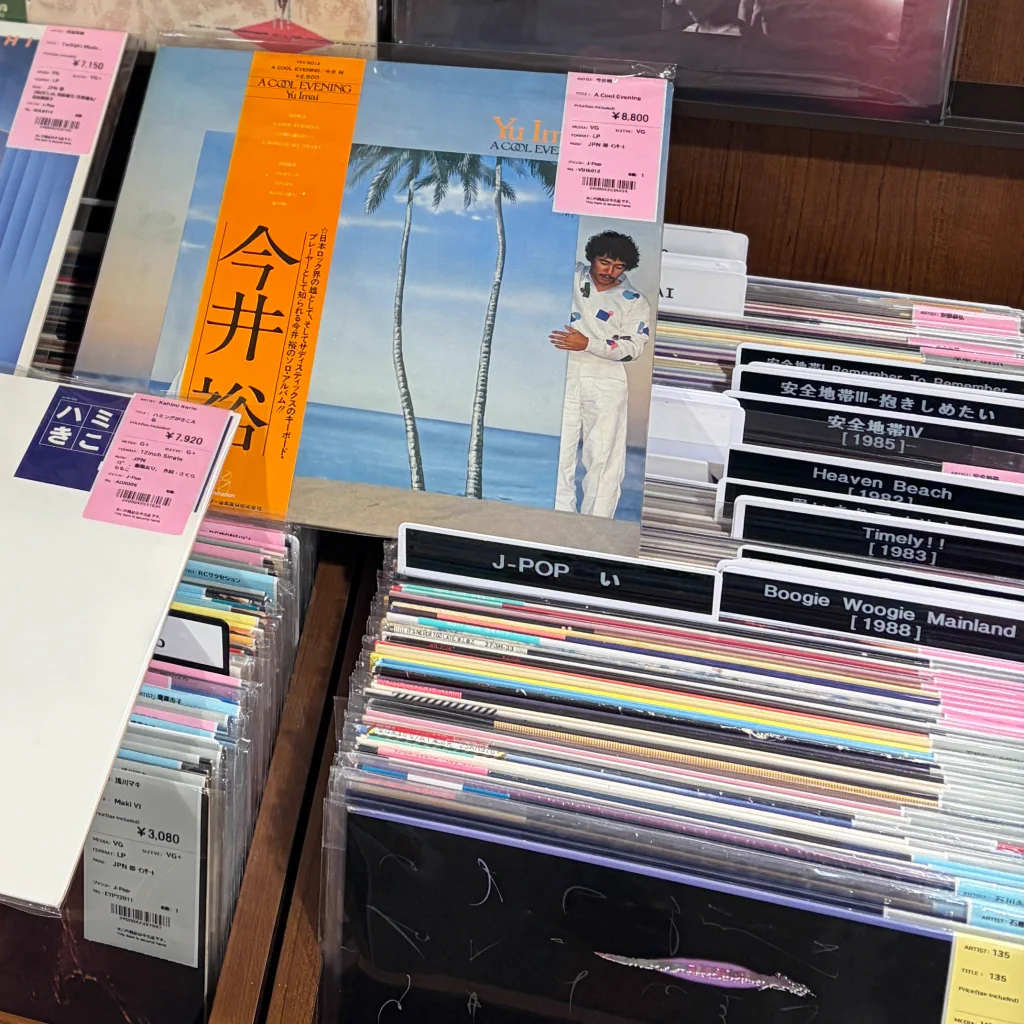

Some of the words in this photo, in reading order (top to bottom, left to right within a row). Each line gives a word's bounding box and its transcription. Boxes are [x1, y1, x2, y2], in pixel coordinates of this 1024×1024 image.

[73, 59, 104, 70] ¥7,150
[258, 78, 266, 88] A
[268, 79, 296, 90] COOL
[299, 82, 352, 94] EVENING
[286, 90, 297, 100] Yu
[299, 91, 319, 102] Imai
[612, 112, 649, 123] ¥8,800
[492, 116, 524, 142] Yu
[490, 141, 499, 151] A
[500, 142, 532, 153] COOL
[158, 400, 180, 408] Kahimi
[827, 414, 924, 439] 安全地帯IV
[165, 431, 203, 445] ¥7,920
[141, 449, 162, 458] 12inch
[163, 453, 183, 462] Single
[813, 467, 883, 489] Heaven
[893, 479, 953, 501] Beach
[492, 554, 570, 578] J-POP
[599, 571, 621, 588] い
[763, 584, 831, 607] Boogie
[842, 596, 916, 622] Woogie
[927, 611, 1017, 639] Mainland
[115, 776, 141, 788] 浅川マキ
[114, 798, 132, 808] Maki
[137, 826, 180, 844] ¥3,080
[113, 840, 124, 848] VG
[166, 851, 183, 860] VG+
[113, 861, 128, 870] JPN
[964, 945, 989, 954] ARTIST:
[993, 949, 1010, 959] 135
[989, 972, 1007, 983] 135
